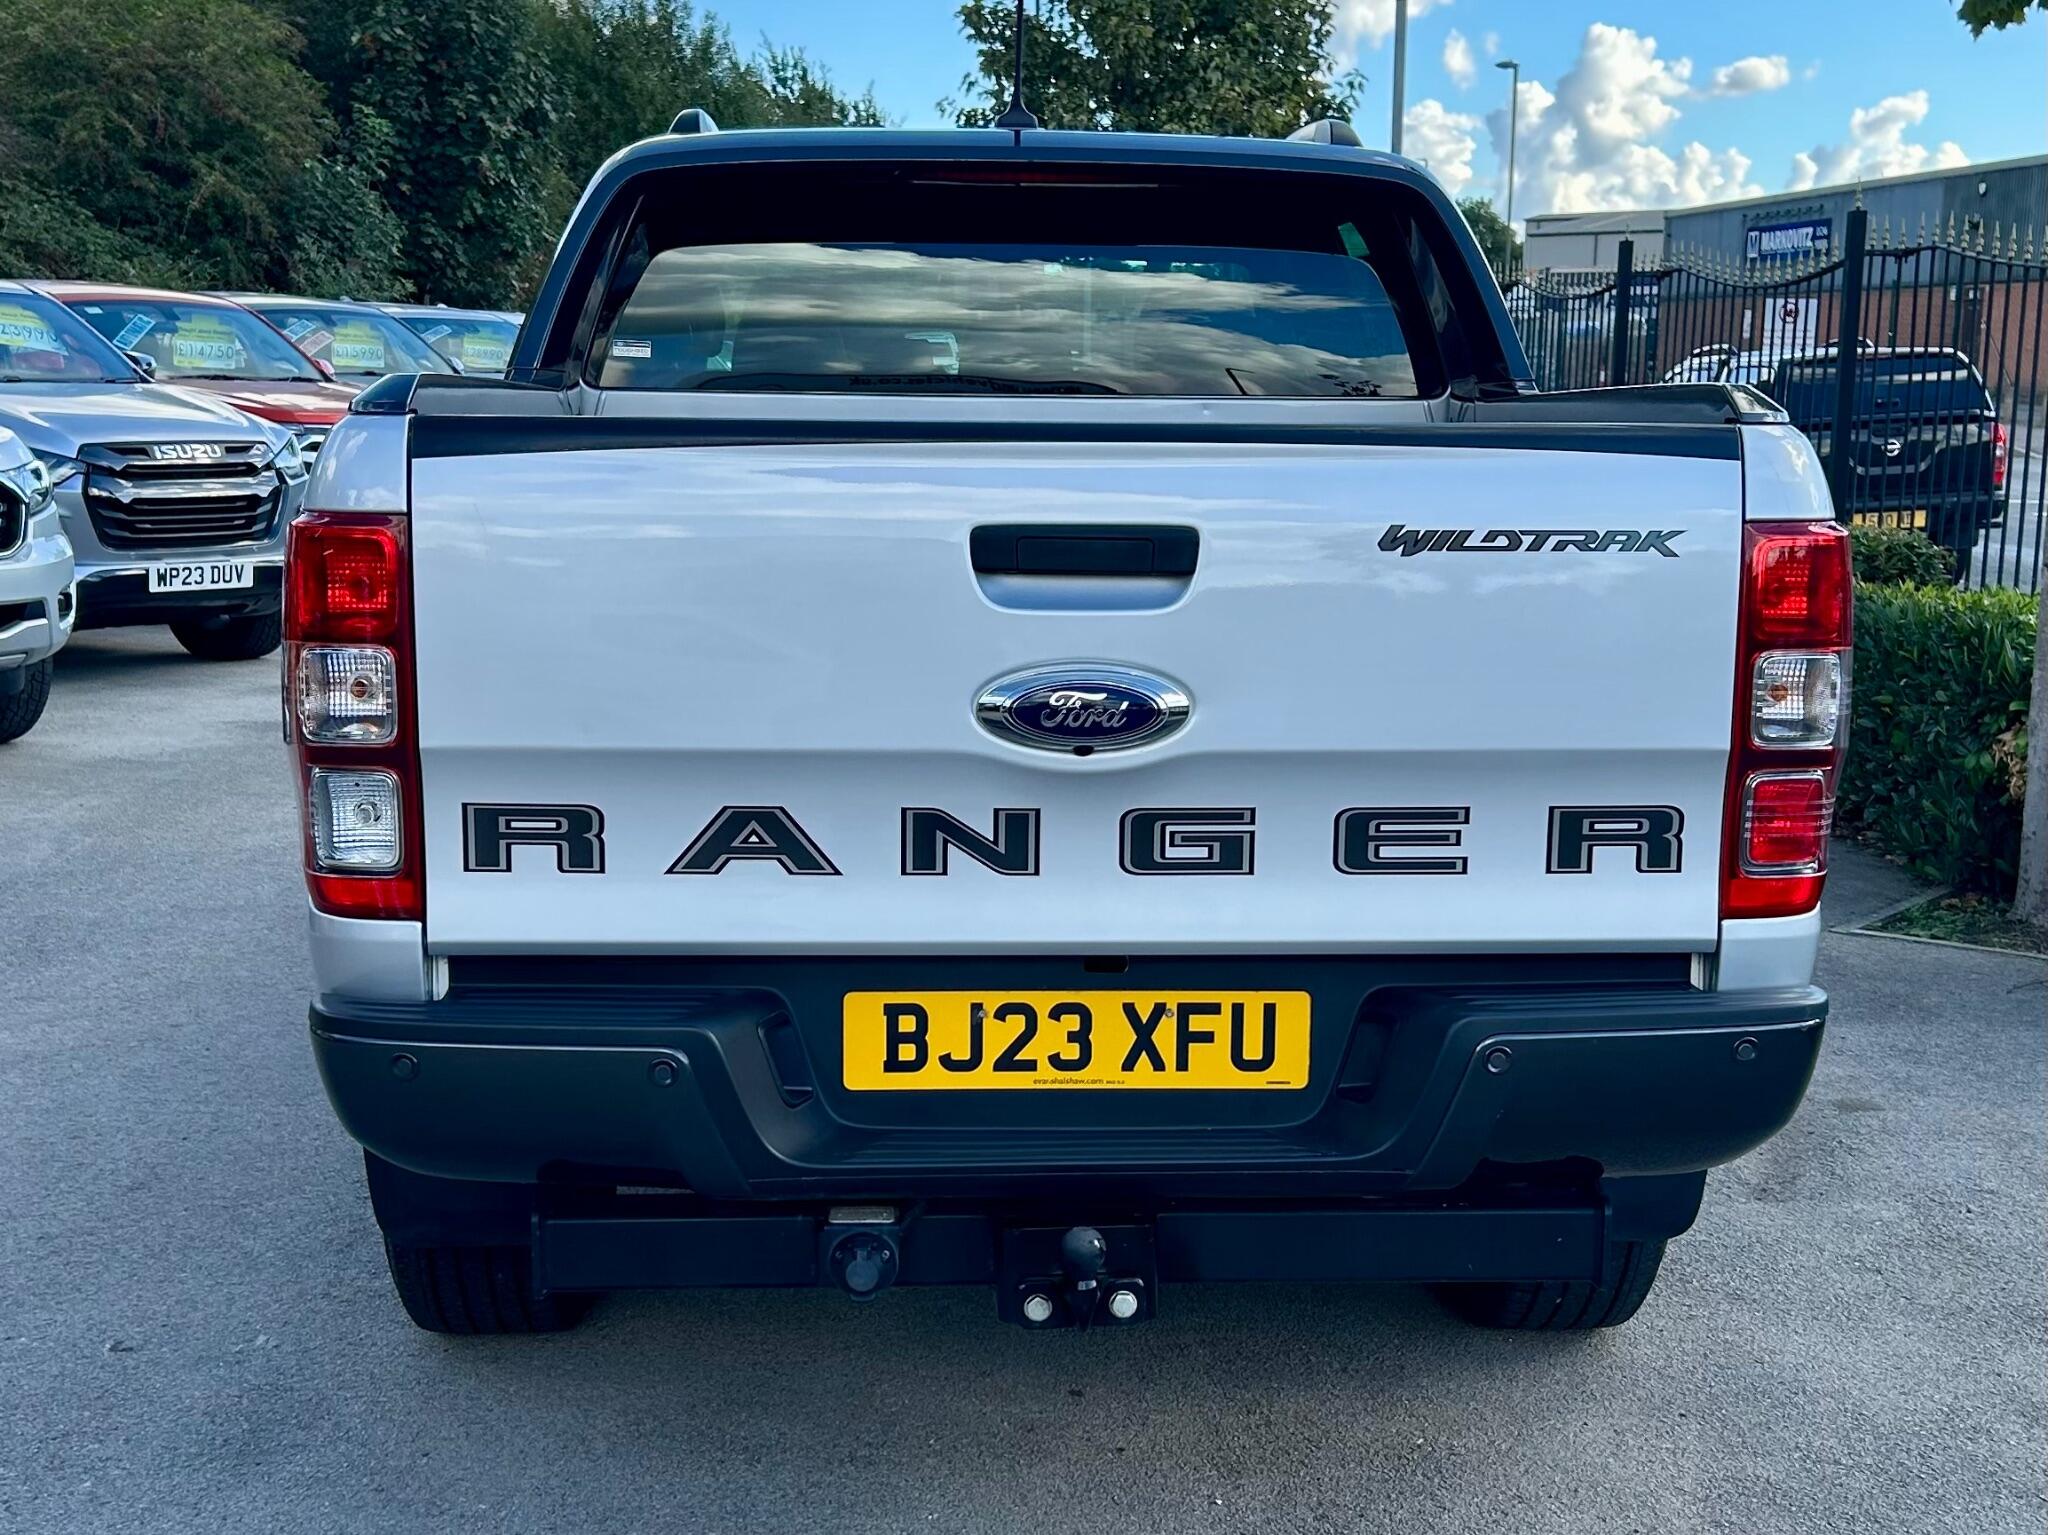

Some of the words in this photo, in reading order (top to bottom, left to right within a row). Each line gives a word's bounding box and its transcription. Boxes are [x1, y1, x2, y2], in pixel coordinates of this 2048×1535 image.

[1760, 227, 1814, 251] MARKOVITZ
[177, 342, 234, 360] £14750
[335, 345, 383, 360] £15990
[153, 444, 221, 459] ISUZU
[1377, 524, 1688, 558] WILDTRAK
[157, 566, 204, 587] WP23
[210, 564, 244, 583] DUV
[1040, 690, 1128, 727] Ford
[461, 802, 1685, 876] RANGER
[883, 1002, 1093, 1073] BJ23
[1121, 1002, 1277, 1073] XFU
